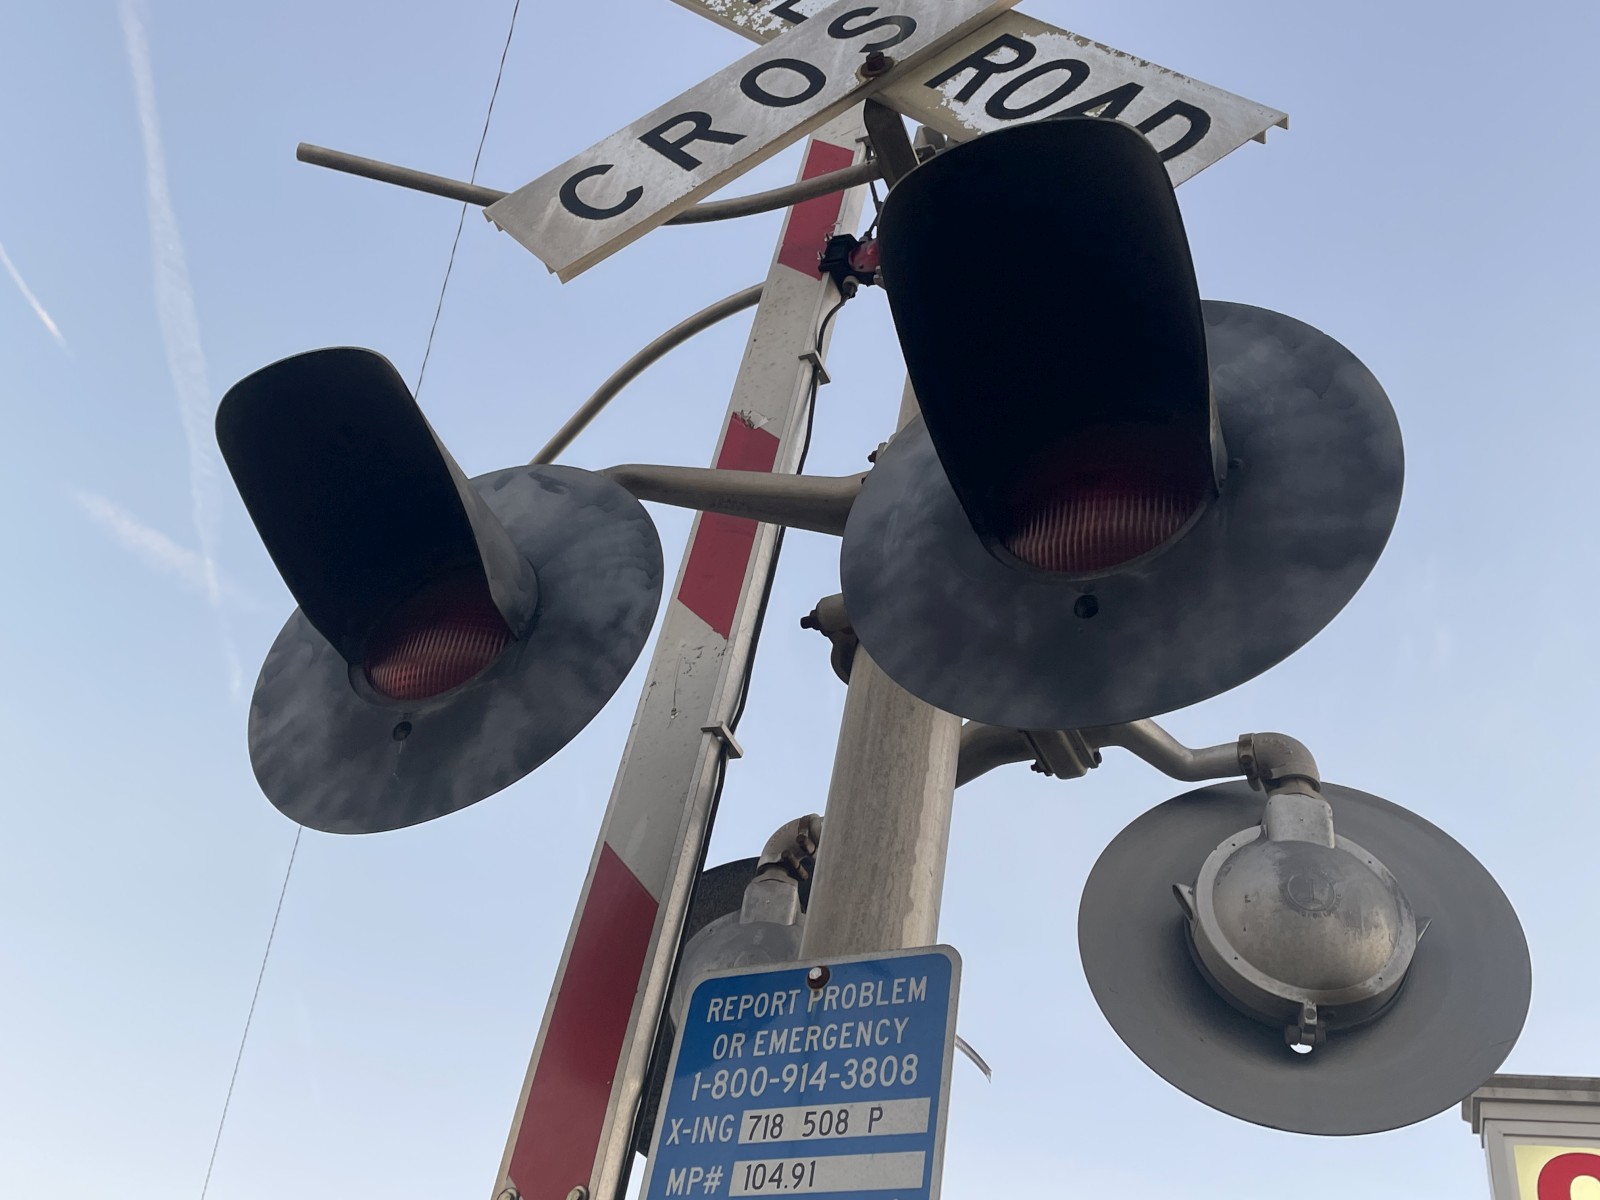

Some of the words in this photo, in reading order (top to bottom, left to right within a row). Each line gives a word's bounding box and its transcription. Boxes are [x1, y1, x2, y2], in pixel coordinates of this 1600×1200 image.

[924, 33, 1212, 162] ROAD
[706, 989, 801, 1023] REPORT
[807, 976, 928, 1013] PROBLEM
[712, 1034, 743, 1060] OR
[753, 1017, 910, 1057] EMERGENCY
[691, 1054, 919, 1102] 1-800-914-3808
[665, 1114, 736, 1146] X-ING
[748, 1113, 784, 1141] 718
[801, 1109, 849, 1138] 508
[867, 1106, 884, 1134] P
[665, 1165, 724, 1197] MP#
[743, 1160, 817, 1191] 104.91
